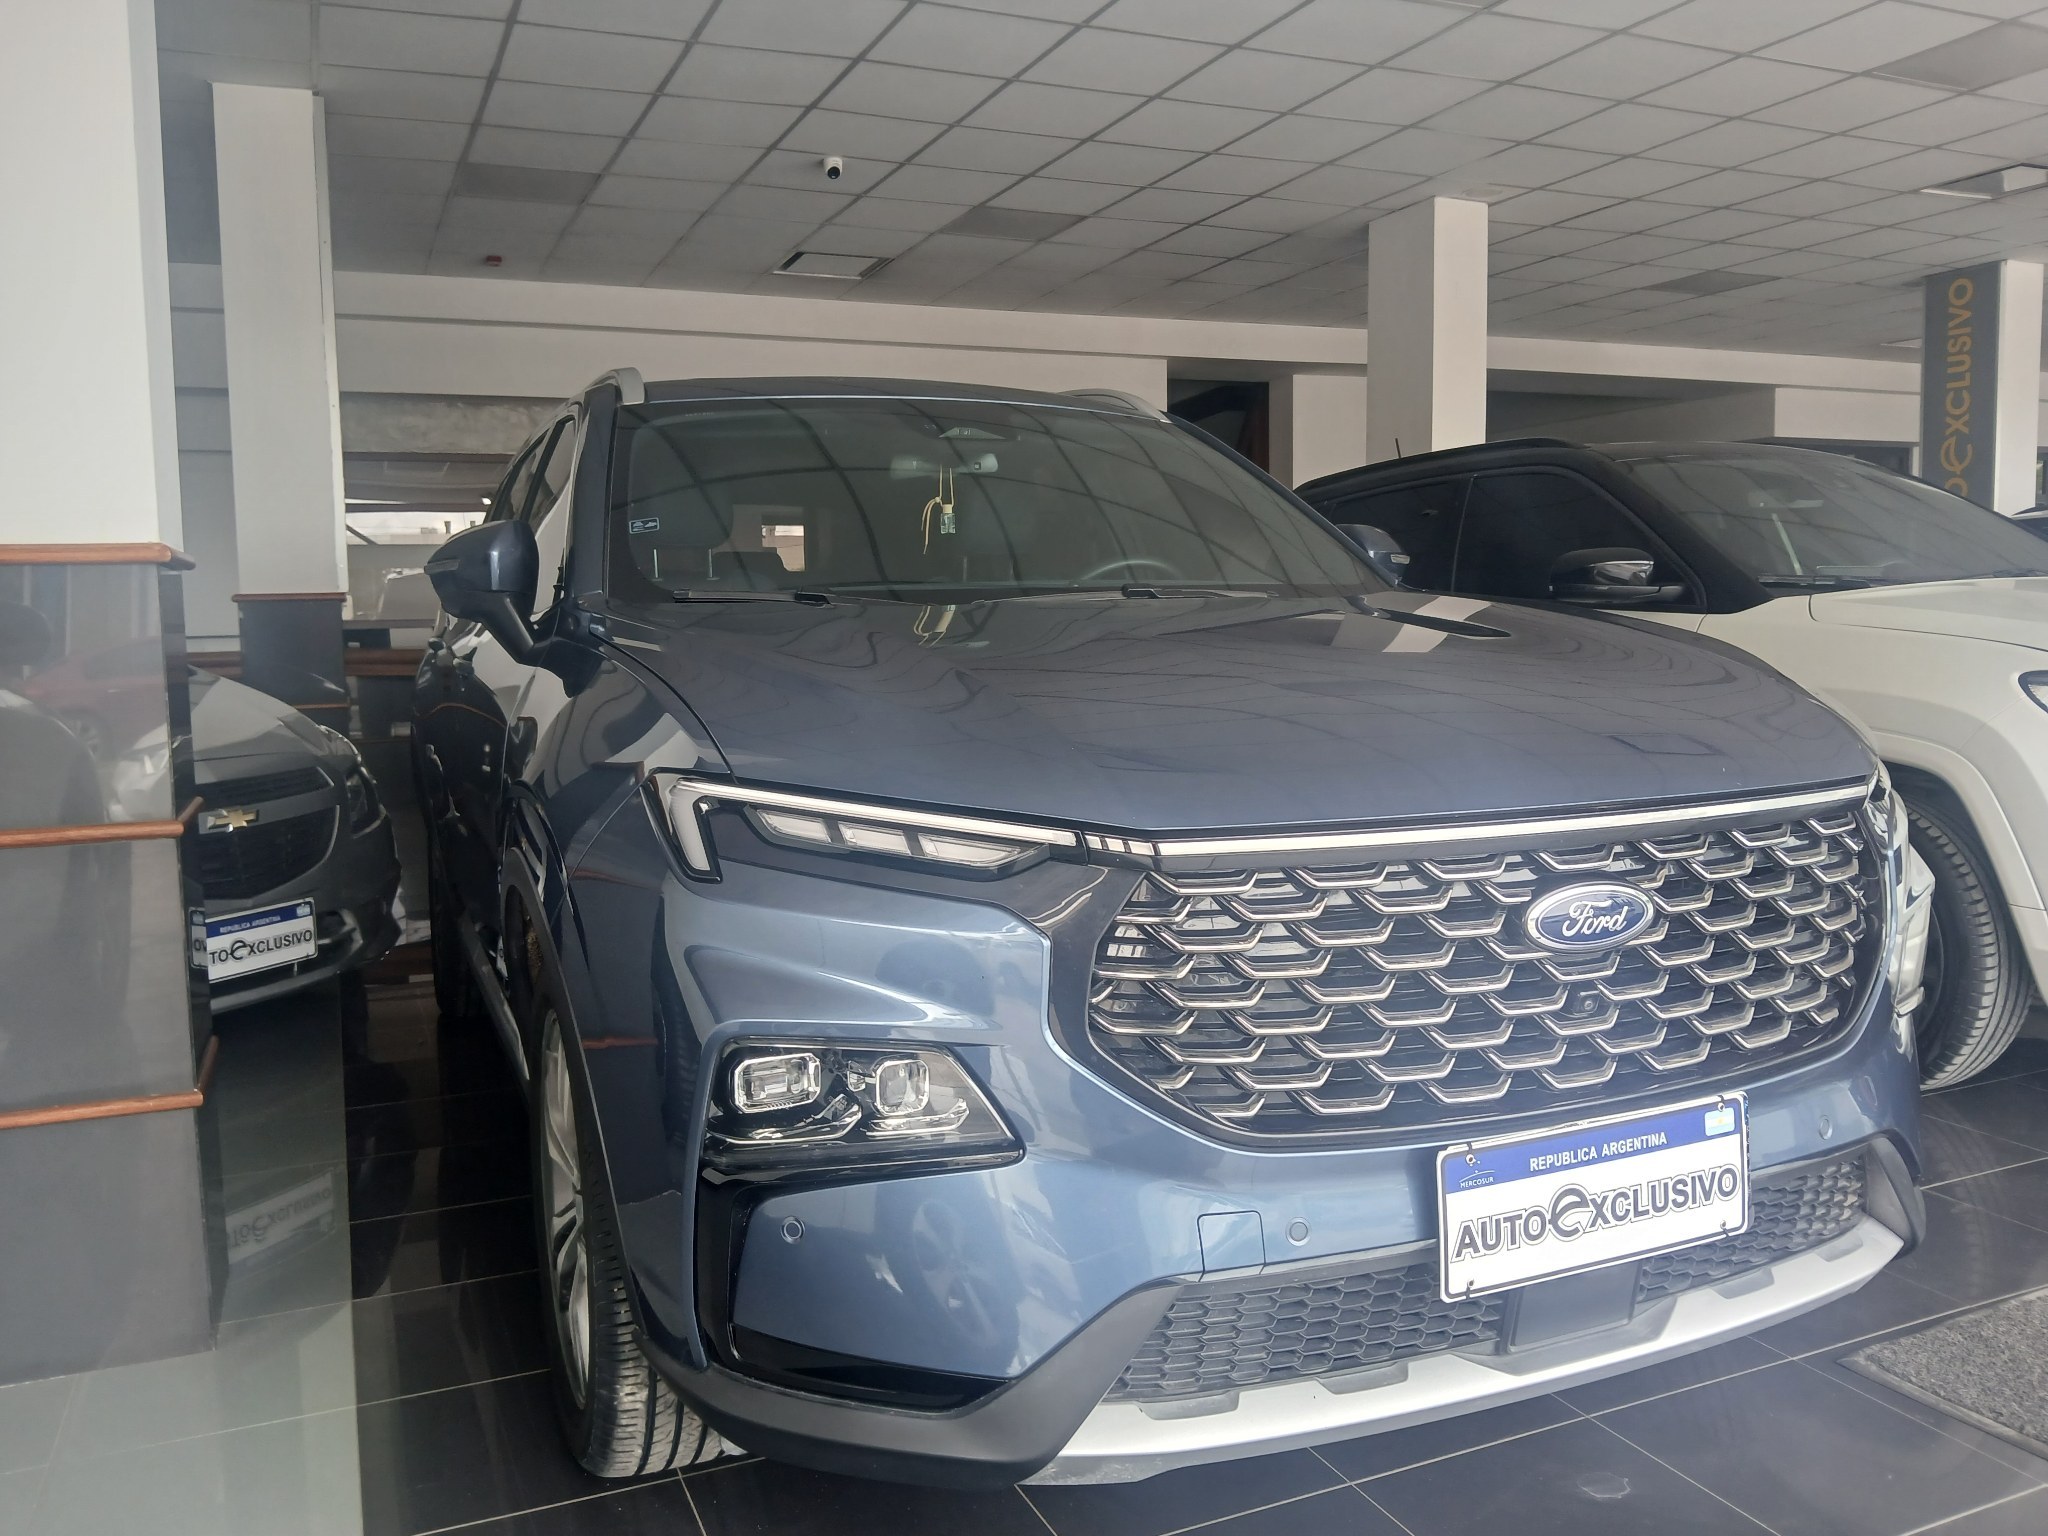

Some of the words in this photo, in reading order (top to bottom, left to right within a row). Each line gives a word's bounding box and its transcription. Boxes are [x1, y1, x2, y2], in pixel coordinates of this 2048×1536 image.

[1940, 277, 1975, 497] OEXCLUSIVO
[1562, 900, 1628, 937] Ford
[208, 929, 313, 965] TOEXCLUSIVO
[1530, 1144, 1598, 1173] REPUBLICA
[1601, 1131, 1668, 1158] ARGENTINA
[1459, 1175, 1495, 1189] MERCOSUR
